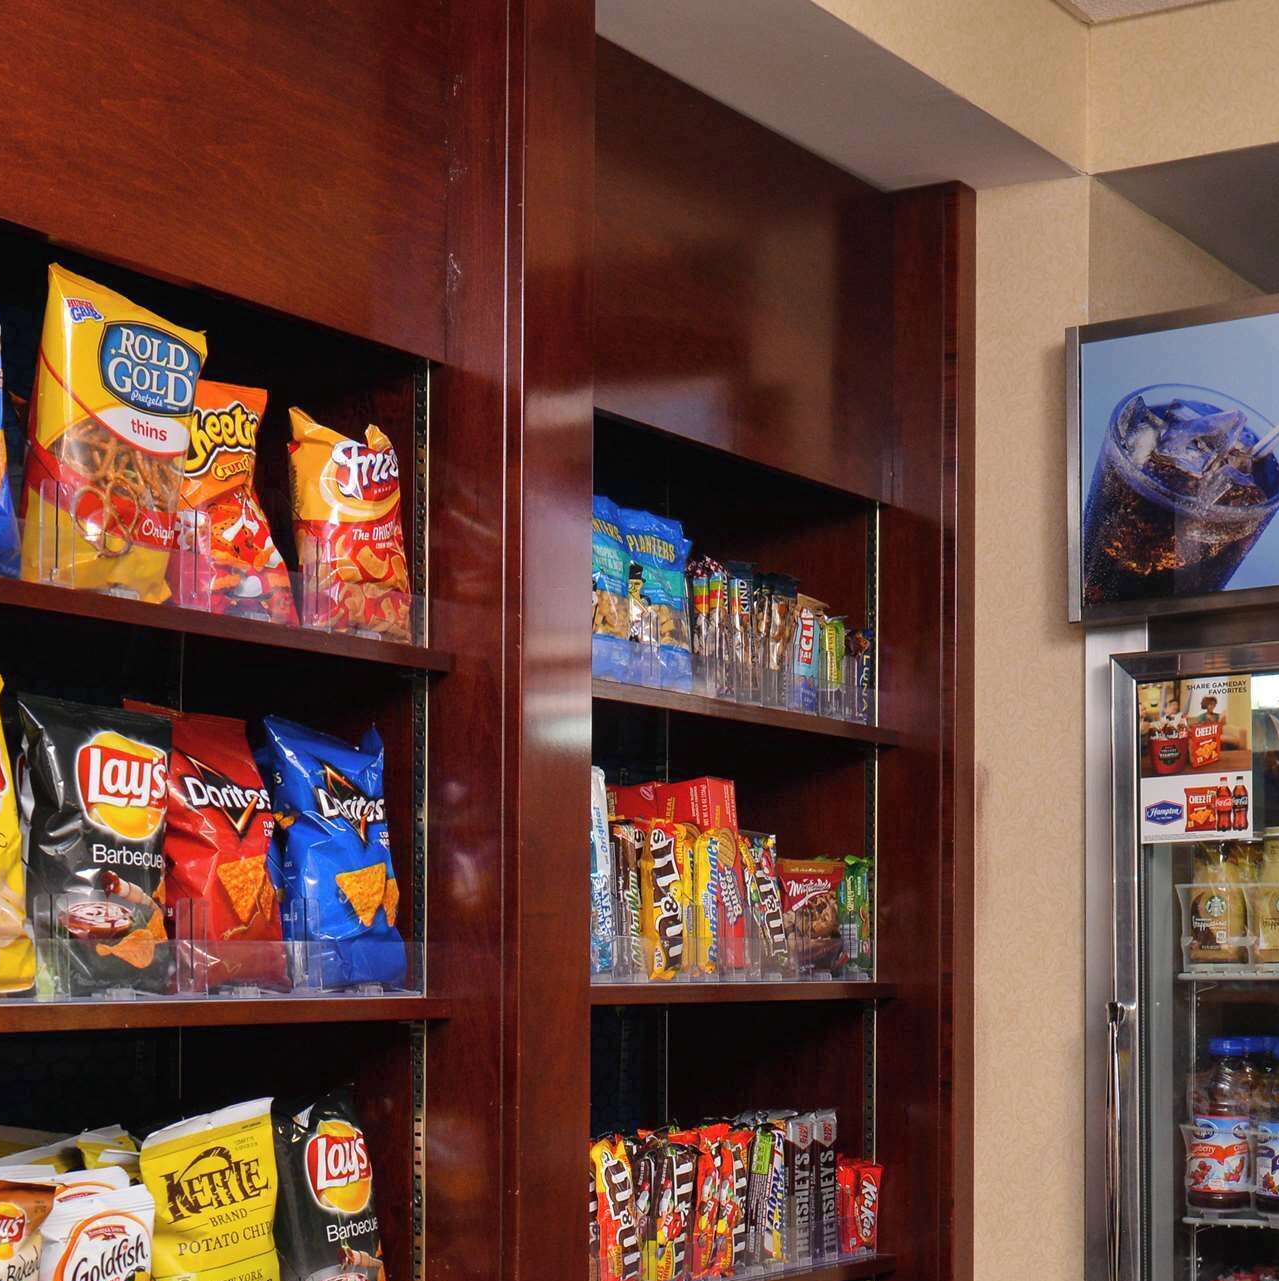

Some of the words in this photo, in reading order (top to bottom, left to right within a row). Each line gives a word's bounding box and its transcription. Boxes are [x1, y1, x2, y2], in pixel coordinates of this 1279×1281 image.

[119, 327, 189, 370] ROLD
[106, 357, 194, 408] GOLD
[130, 389, 163, 408] Pretzels
[130, 417, 168, 443] thins
[352, 528, 370, 542] The
[625, 534, 676, 564] PLANTERS
[740, 579, 750, 615] KIND
[860, 655, 871, 713] LUNA
[1208, 687, 1247, 695] FAVORITES
[1212, 680, 1247, 689] GAMEDAY
[88, 748, 168, 808] Lay's
[183, 776, 272, 812] Doritos
[317, 787, 385, 824] Doritos
[1147, 805, 1182, 819] Hampton
[92, 843, 165, 870] Barbecue
[706, 837, 719, 962] Butterfinger
[317, 1134, 368, 1190] Lay's
[160, 1146, 271, 1224] KETTLE
[209, 1207, 248, 1228] BRAND
[795, 1152, 811, 1258] HERSHEY'S
[820, 1149, 839, 1260] HERSHEY'S
[178, 1232, 240, 1256] POTATO
[326, 1215, 379, 1244] Barbecue
